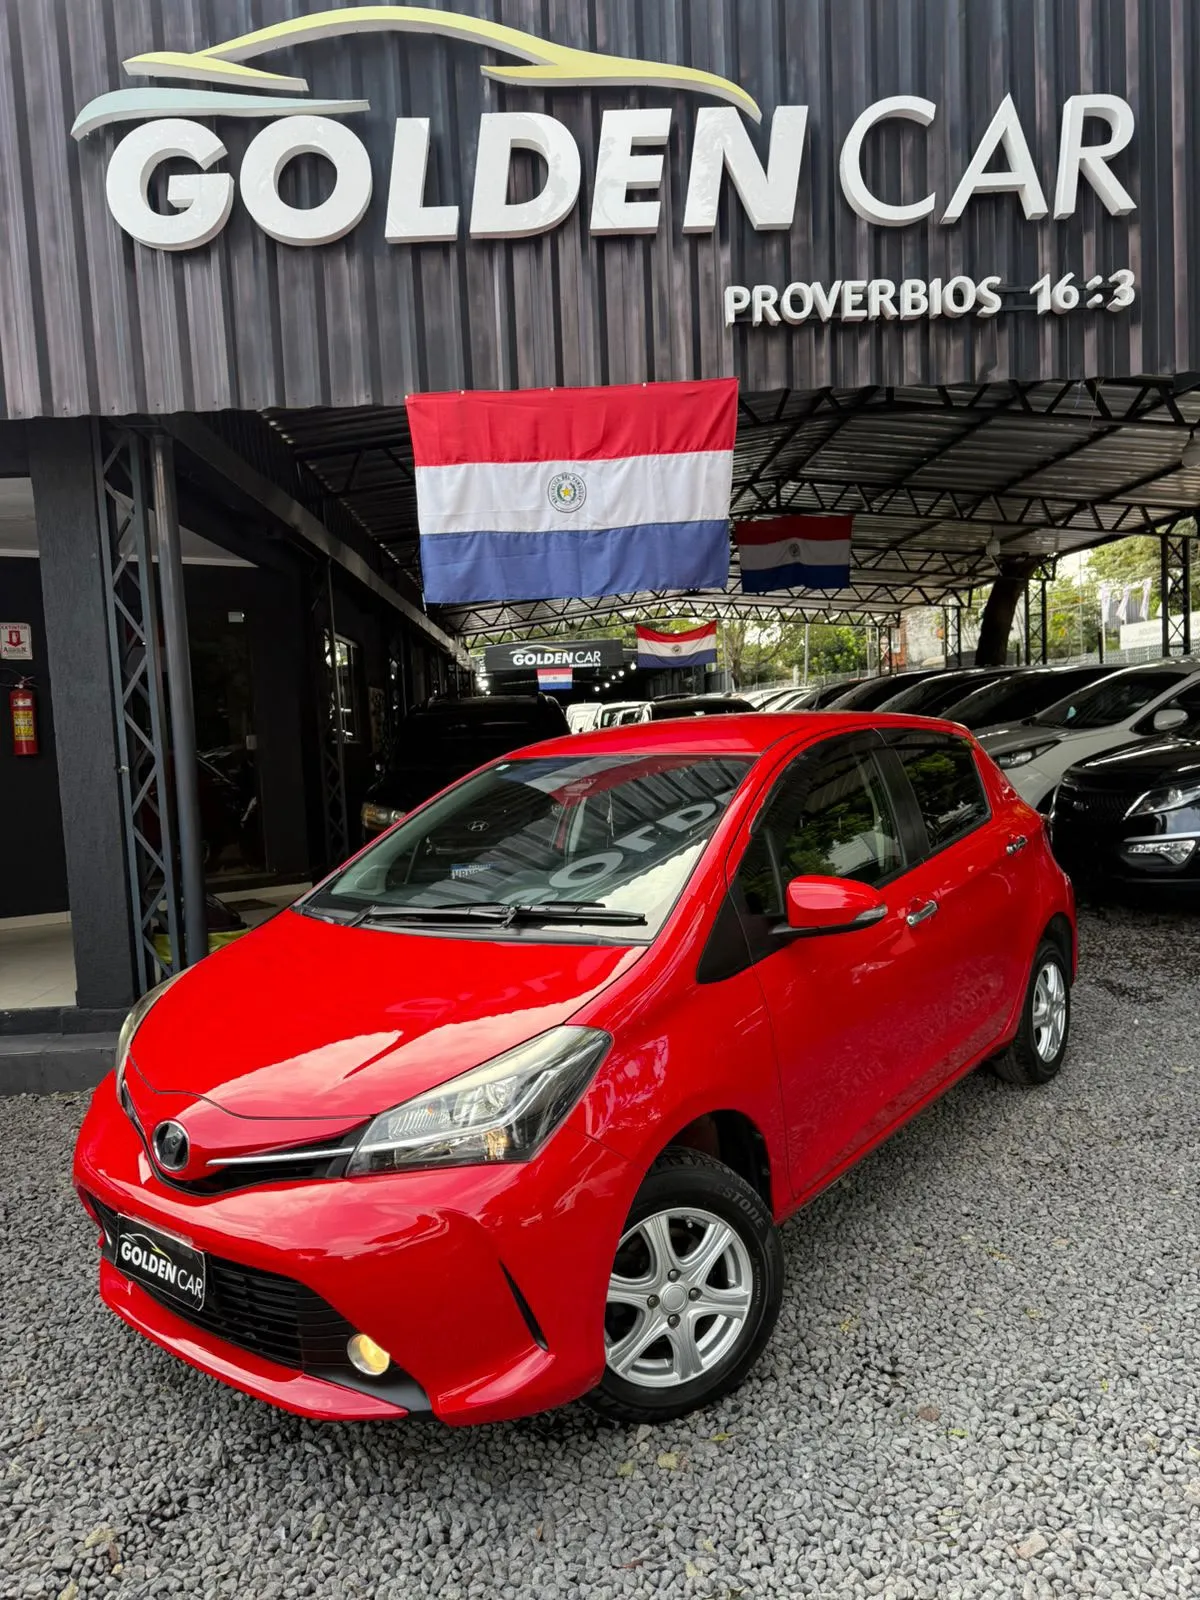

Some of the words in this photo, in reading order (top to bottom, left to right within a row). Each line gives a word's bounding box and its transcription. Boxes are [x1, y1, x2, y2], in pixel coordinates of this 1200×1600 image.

[106, 106, 808, 251] GOLDEN
[839, 93, 1137, 227] CAR
[724, 275, 1002, 327] PROVERBIOS
[1030, 269, 1136, 316] 16:3
[512, 652, 574, 666] GOLDEN
[574, 651, 601, 664] CAR
[121, 1241, 177, 1284] GOLDEN
[177, 1269, 203, 1299] CAR
